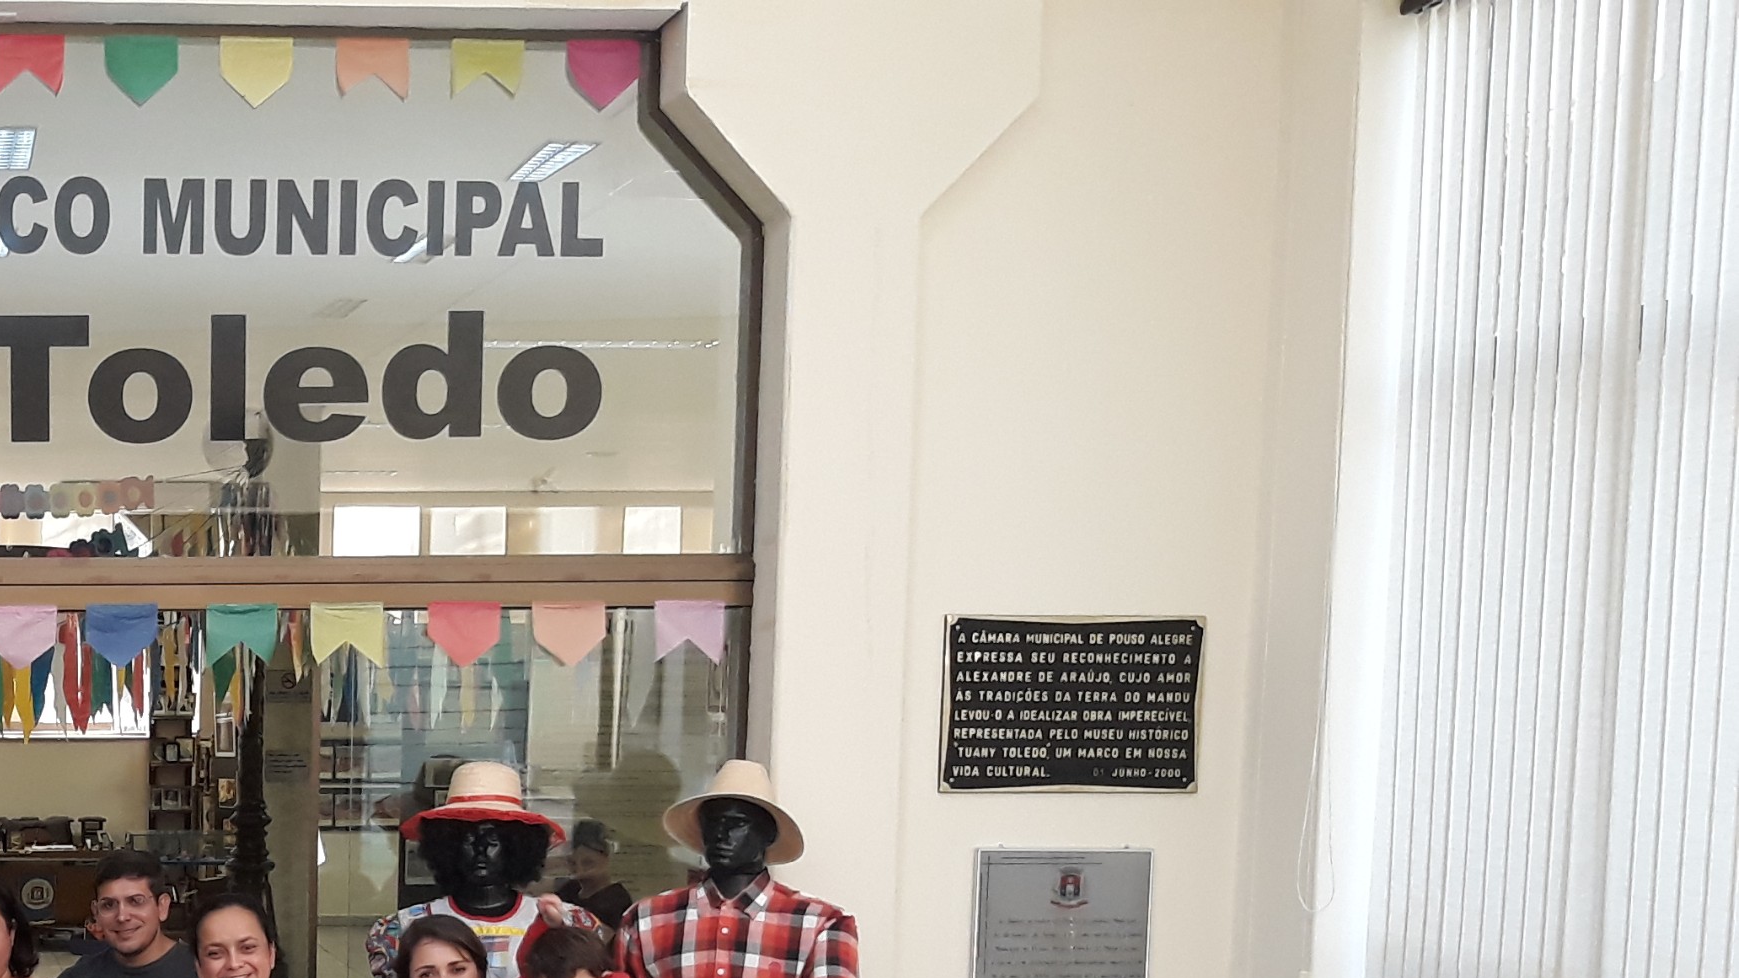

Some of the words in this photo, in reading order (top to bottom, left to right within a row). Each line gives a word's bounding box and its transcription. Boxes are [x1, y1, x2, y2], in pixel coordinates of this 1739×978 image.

[143, 177, 605, 260] MUNICIPAL
[957, 632, 967, 644] A
[971, 629, 1021, 645] CÂMARA
[1025, 633, 1085, 645] MUNICIPAL
[1088, 633, 1104, 645] DE
[1108, 633, 1145, 645] POUSO
[1149, 634, 1194, 646] ALEGRE
[956, 651, 1023, 664] EXPRESSA
[1030, 652, 1056, 664] SEU
[1062, 652, 1176, 665] RECONHECIMENTO
[1183, 653, 1192, 665] A
[955, 670, 1033, 683] ALEXANDRE
[1037, 671, 1054, 683] DE
[1118, 671, 1151, 684] CUJO
[1156, 672, 1192, 684] AMOR
[1055, 690, 1072, 702] DA
[1077, 690, 1117, 703] TERRA
[1124, 690, 1140, 703] DO
[1146, 691, 1191, 704] MANDU
[1019, 710, 1078, 722] IDEALIZAR
[1082, 710, 1113, 722] OBRA
[953, 728, 1043, 740] REPRESENTADA
[1049, 728, 1079, 740] PELO
[1083, 729, 1124, 741] MUSEU
[1055, 747, 1072, 759] UM
[1077, 747, 1119, 760] MARCO
[1124, 748, 1142, 760] EM
[1147, 748, 1187, 760] NOSSA
[952, 765, 980, 777] VIDA
